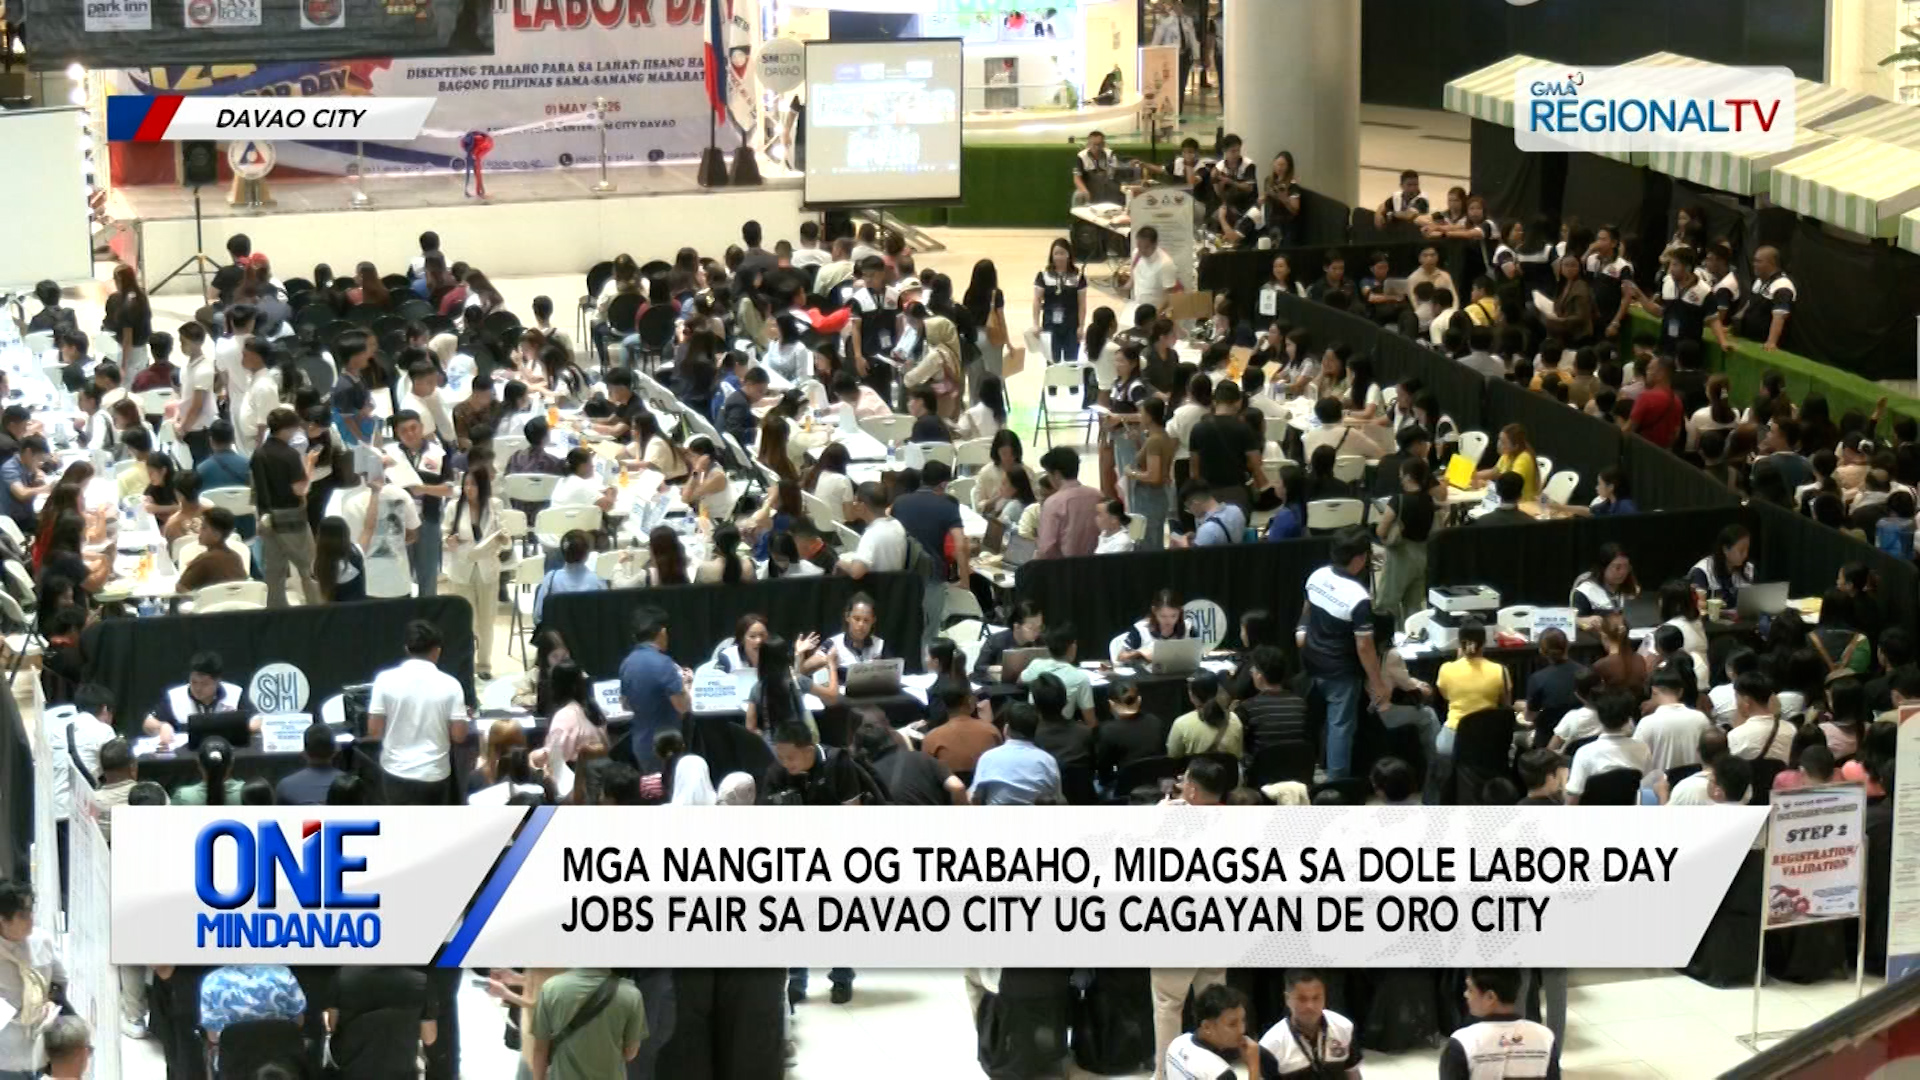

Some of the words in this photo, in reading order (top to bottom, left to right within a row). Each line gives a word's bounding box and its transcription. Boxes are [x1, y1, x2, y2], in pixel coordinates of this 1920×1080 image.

[407, 66, 477, 80] DISENTENG
[480, 63, 539, 76] TRABAHO
[542, 62, 574, 73] PARA
[578, 61, 593, 72] SA
[438, 79, 489, 92] BAGONG
[492, 77, 553, 90] PILIPINAS
[559, 103, 587, 114] MAY
[639, 119, 676, 129] DAVAO
[1786, 826, 1834, 844] STEP
[1837, 824, 1848, 837] 2
[1782, 857, 1849, 877] VALIDATION
